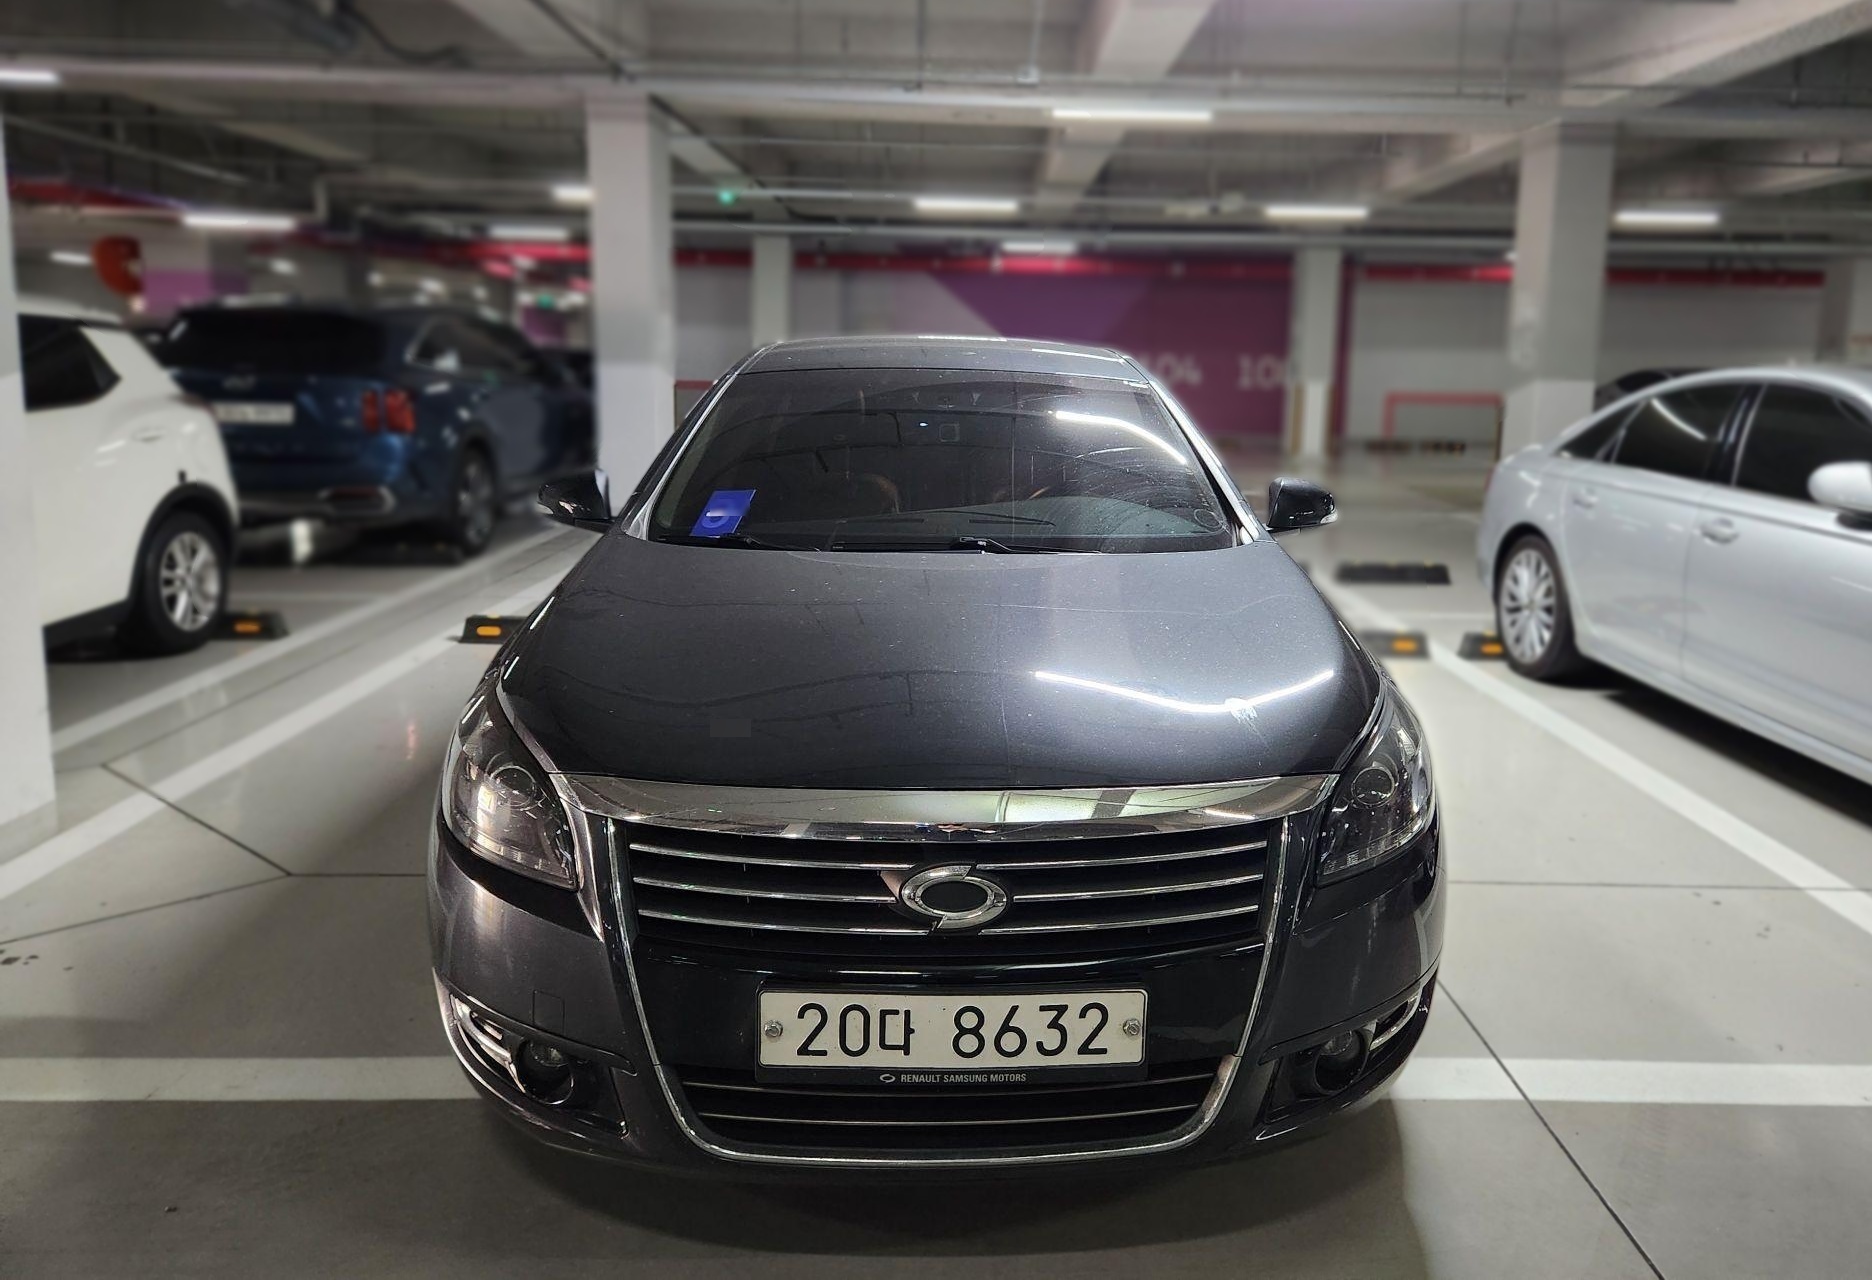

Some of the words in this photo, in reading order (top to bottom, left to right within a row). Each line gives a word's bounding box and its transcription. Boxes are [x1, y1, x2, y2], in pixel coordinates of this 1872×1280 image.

[797, 1002, 916, 1057] 20다
[952, 1002, 1109, 1059] 8632
[900, 1073, 941, 1083] RENAULT
[943, 1073, 988, 1083] SAMSUNG
[989, 1072, 1027, 1082] MOTORS
